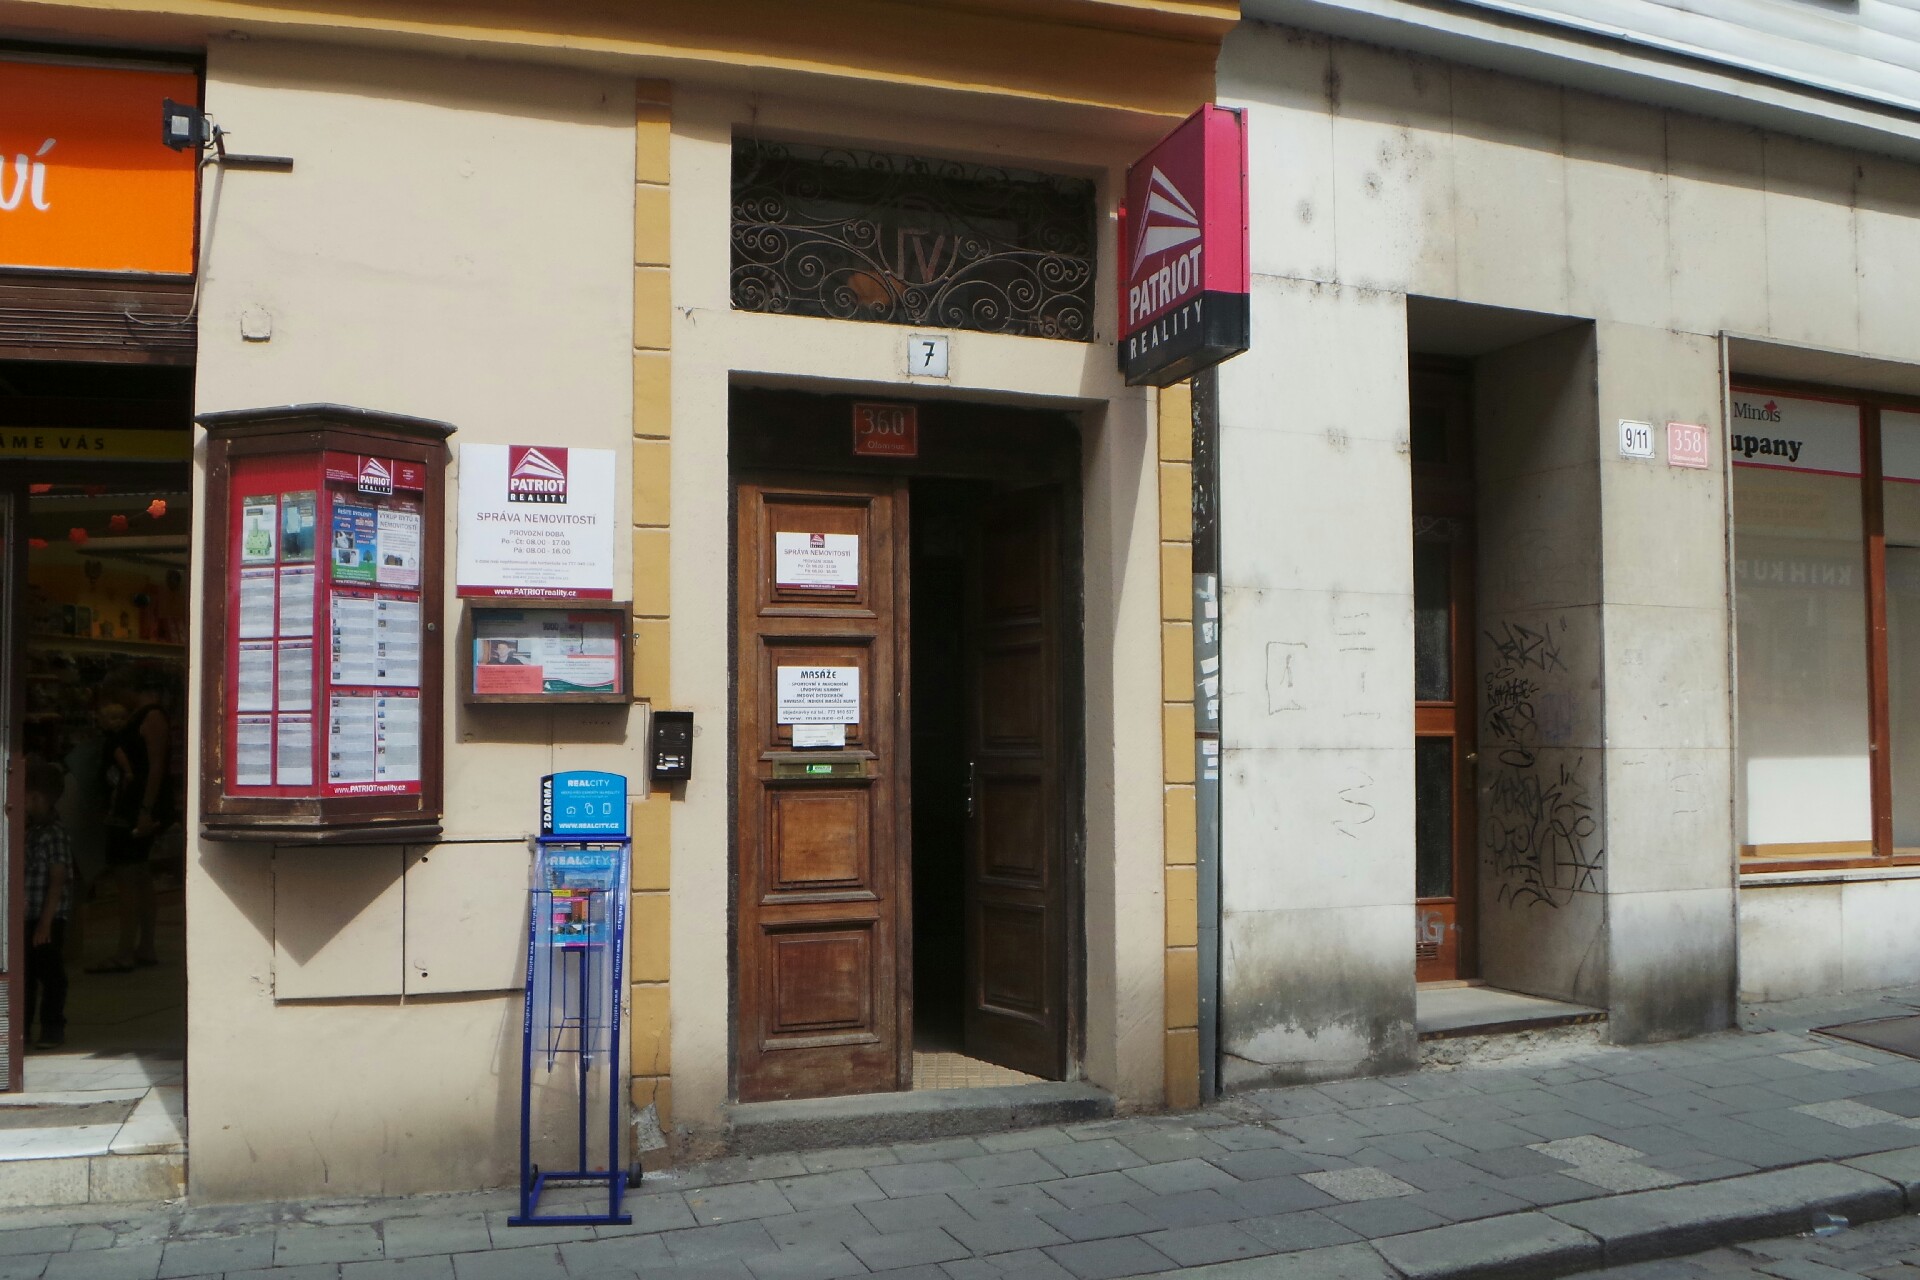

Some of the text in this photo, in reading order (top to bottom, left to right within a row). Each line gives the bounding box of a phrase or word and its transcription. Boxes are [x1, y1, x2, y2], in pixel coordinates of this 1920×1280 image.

[1129, 244, 1202, 326] PATRIOT
[1130, 298, 1203, 360] REALITY
[921, 341, 936, 368] 7
[860, 408, 905, 436] 360
[59, 433, 105, 450] VÁS
[1625, 427, 1649, 451] 9/11
[1674, 429, 1702, 453] 358
[360, 475, 391, 486] PATRIOT
[510, 478, 565, 493] PATRIOT
[510, 493, 565, 503] REALITY
[476, 510, 596, 526] SPRÁVA NEMOVITOSTÍ
[509, 529, 565, 538] PROVOZNÍ DOBA
[501, 537, 510, 545] Po
[784, 547, 851, 558] SPRÁVA NEMOVITOSTÍ
[493, 588, 577, 598] www.PATRIOTreality.cz
[800, 669, 837, 679] MASÁŽE
[334, 783, 406, 794] www.PATRIOTreality.cz
[567, 779, 609, 787] REALCITY
[543, 780, 552, 829] ZDARMA
[550, 855, 610, 866] REALCITY
